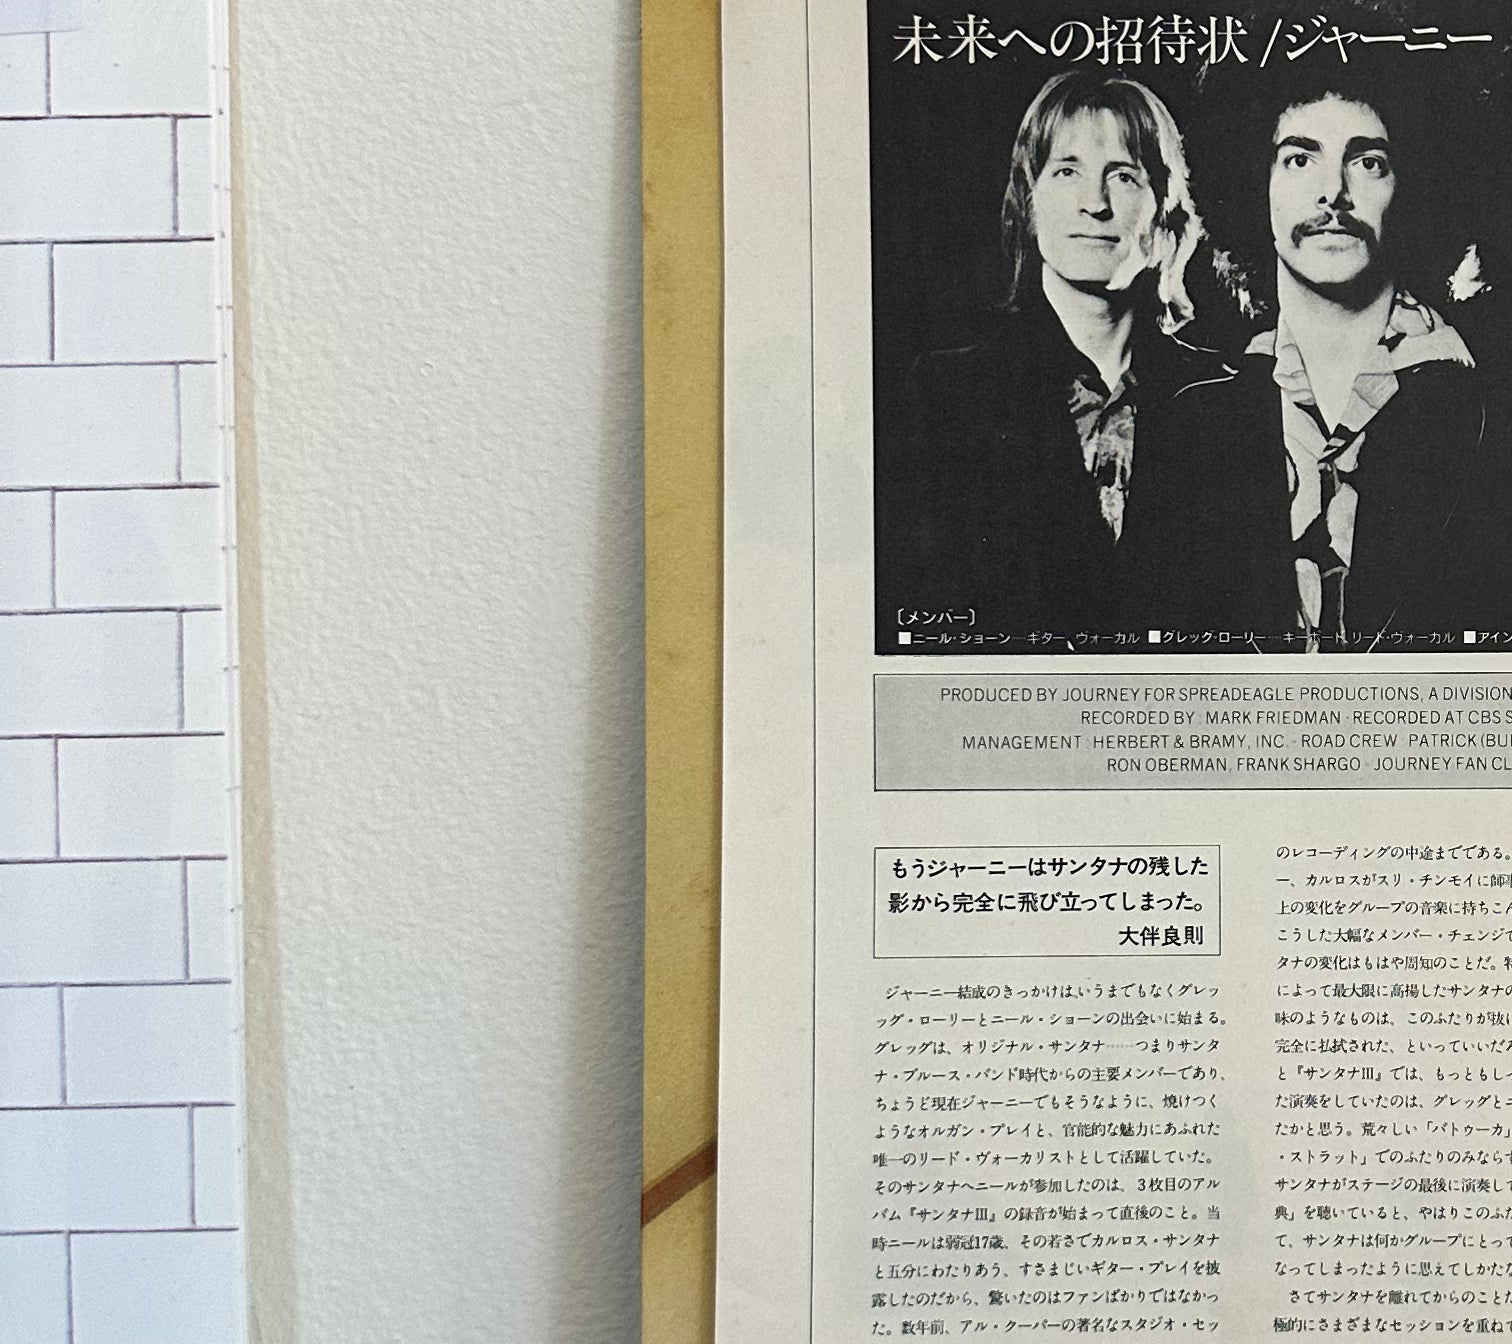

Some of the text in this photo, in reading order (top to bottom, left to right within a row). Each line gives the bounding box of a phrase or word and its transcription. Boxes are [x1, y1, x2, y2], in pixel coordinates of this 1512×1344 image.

[941, 688, 1032, 702] PRODUCED
[1037, 688, 1057, 701] BY
[1062, 688, 1140, 701] JOURNEY
[1145, 688, 1175, 701] FOR
[1179, 687, 1294, 701] SPREADEAGLE
[1444, 687, 1512, 700] DIVISION
[1081, 711, 1169, 724] RECORDED
[1175, 711, 1195, 724] BY
[1206, 711, 1251, 724] MARK
[1257, 711, 1340, 724] FRIEDMAN
[1354, 711, 1440, 724] RECORDED
[1445, 711, 1464, 724] AT
[1468, 710, 1501, 724] CBS
[963, 736, 1081, 749] MANAGEMENT
[1094, 735, 1169, 749] HERBERT
[1302, 734, 1345, 748] ROAD
[1350, 734, 1397, 748] CREW
[1409, 734, 1476, 747] PATRICK
[1108, 758, 1140, 772] RON
[1237, 757, 1289, 771] FRANK
[1294, 757, 1360, 771] SHARGO
[1374, 757, 1451, 771] JOURNEY
[1457, 757, 1486, 770] FAN
[1119, 925, 1203, 946] 大伴良則
